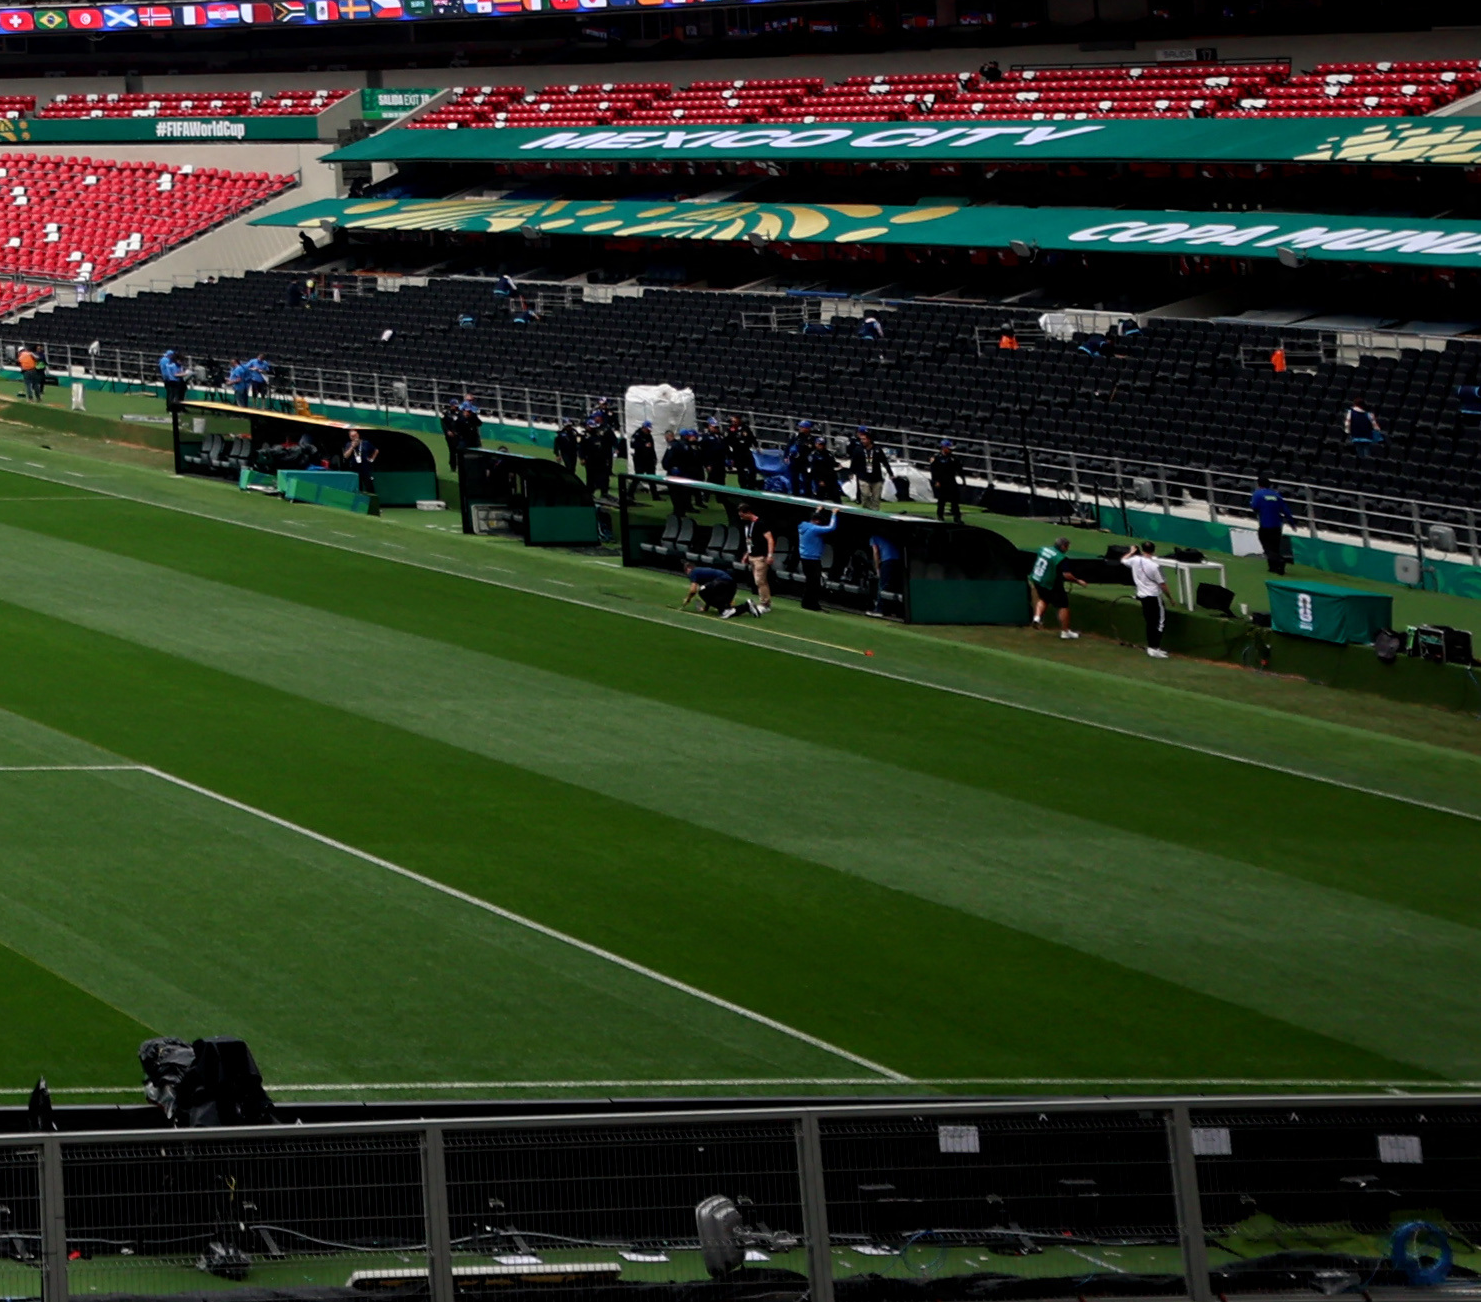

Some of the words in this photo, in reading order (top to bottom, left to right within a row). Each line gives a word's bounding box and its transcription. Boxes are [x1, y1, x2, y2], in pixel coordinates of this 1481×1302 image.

[378, 95, 402, 106] SALIDA
[404, 94, 419, 105] EXIT
[156, 121, 245, 139] #FIFAWorldCup
[519, 129, 854, 149] MEXICO
[850, 125, 1108, 148] CITY
[1068, 221, 1280, 247] COPA
